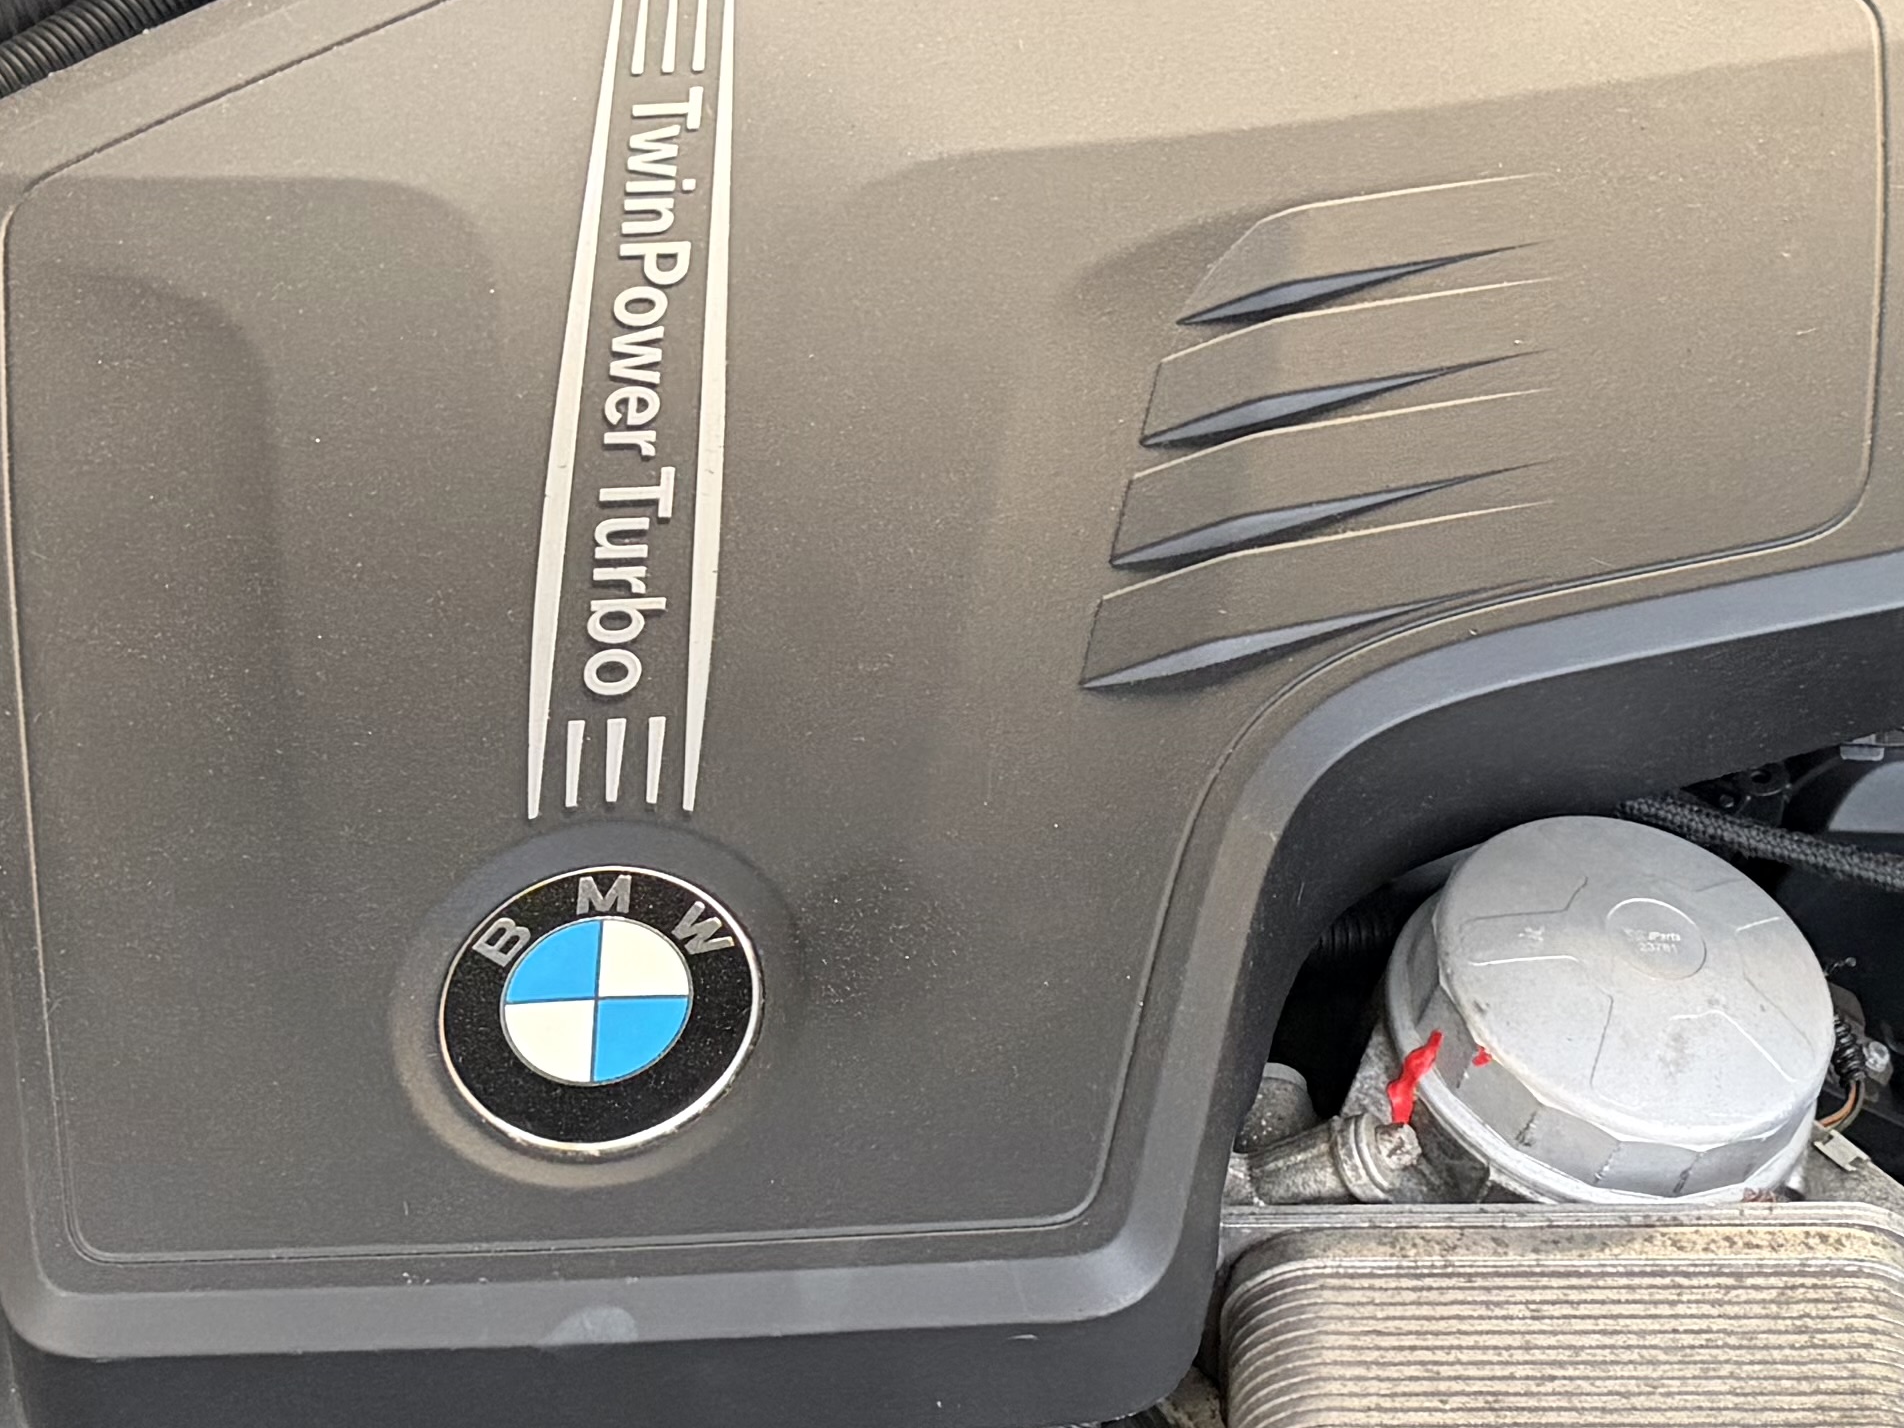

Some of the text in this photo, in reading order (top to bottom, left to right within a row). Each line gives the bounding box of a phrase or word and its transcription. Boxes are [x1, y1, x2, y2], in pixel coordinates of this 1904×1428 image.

[582, 85, 705, 697] TwinPower Turbo
[472, 873, 735, 968] BMW
